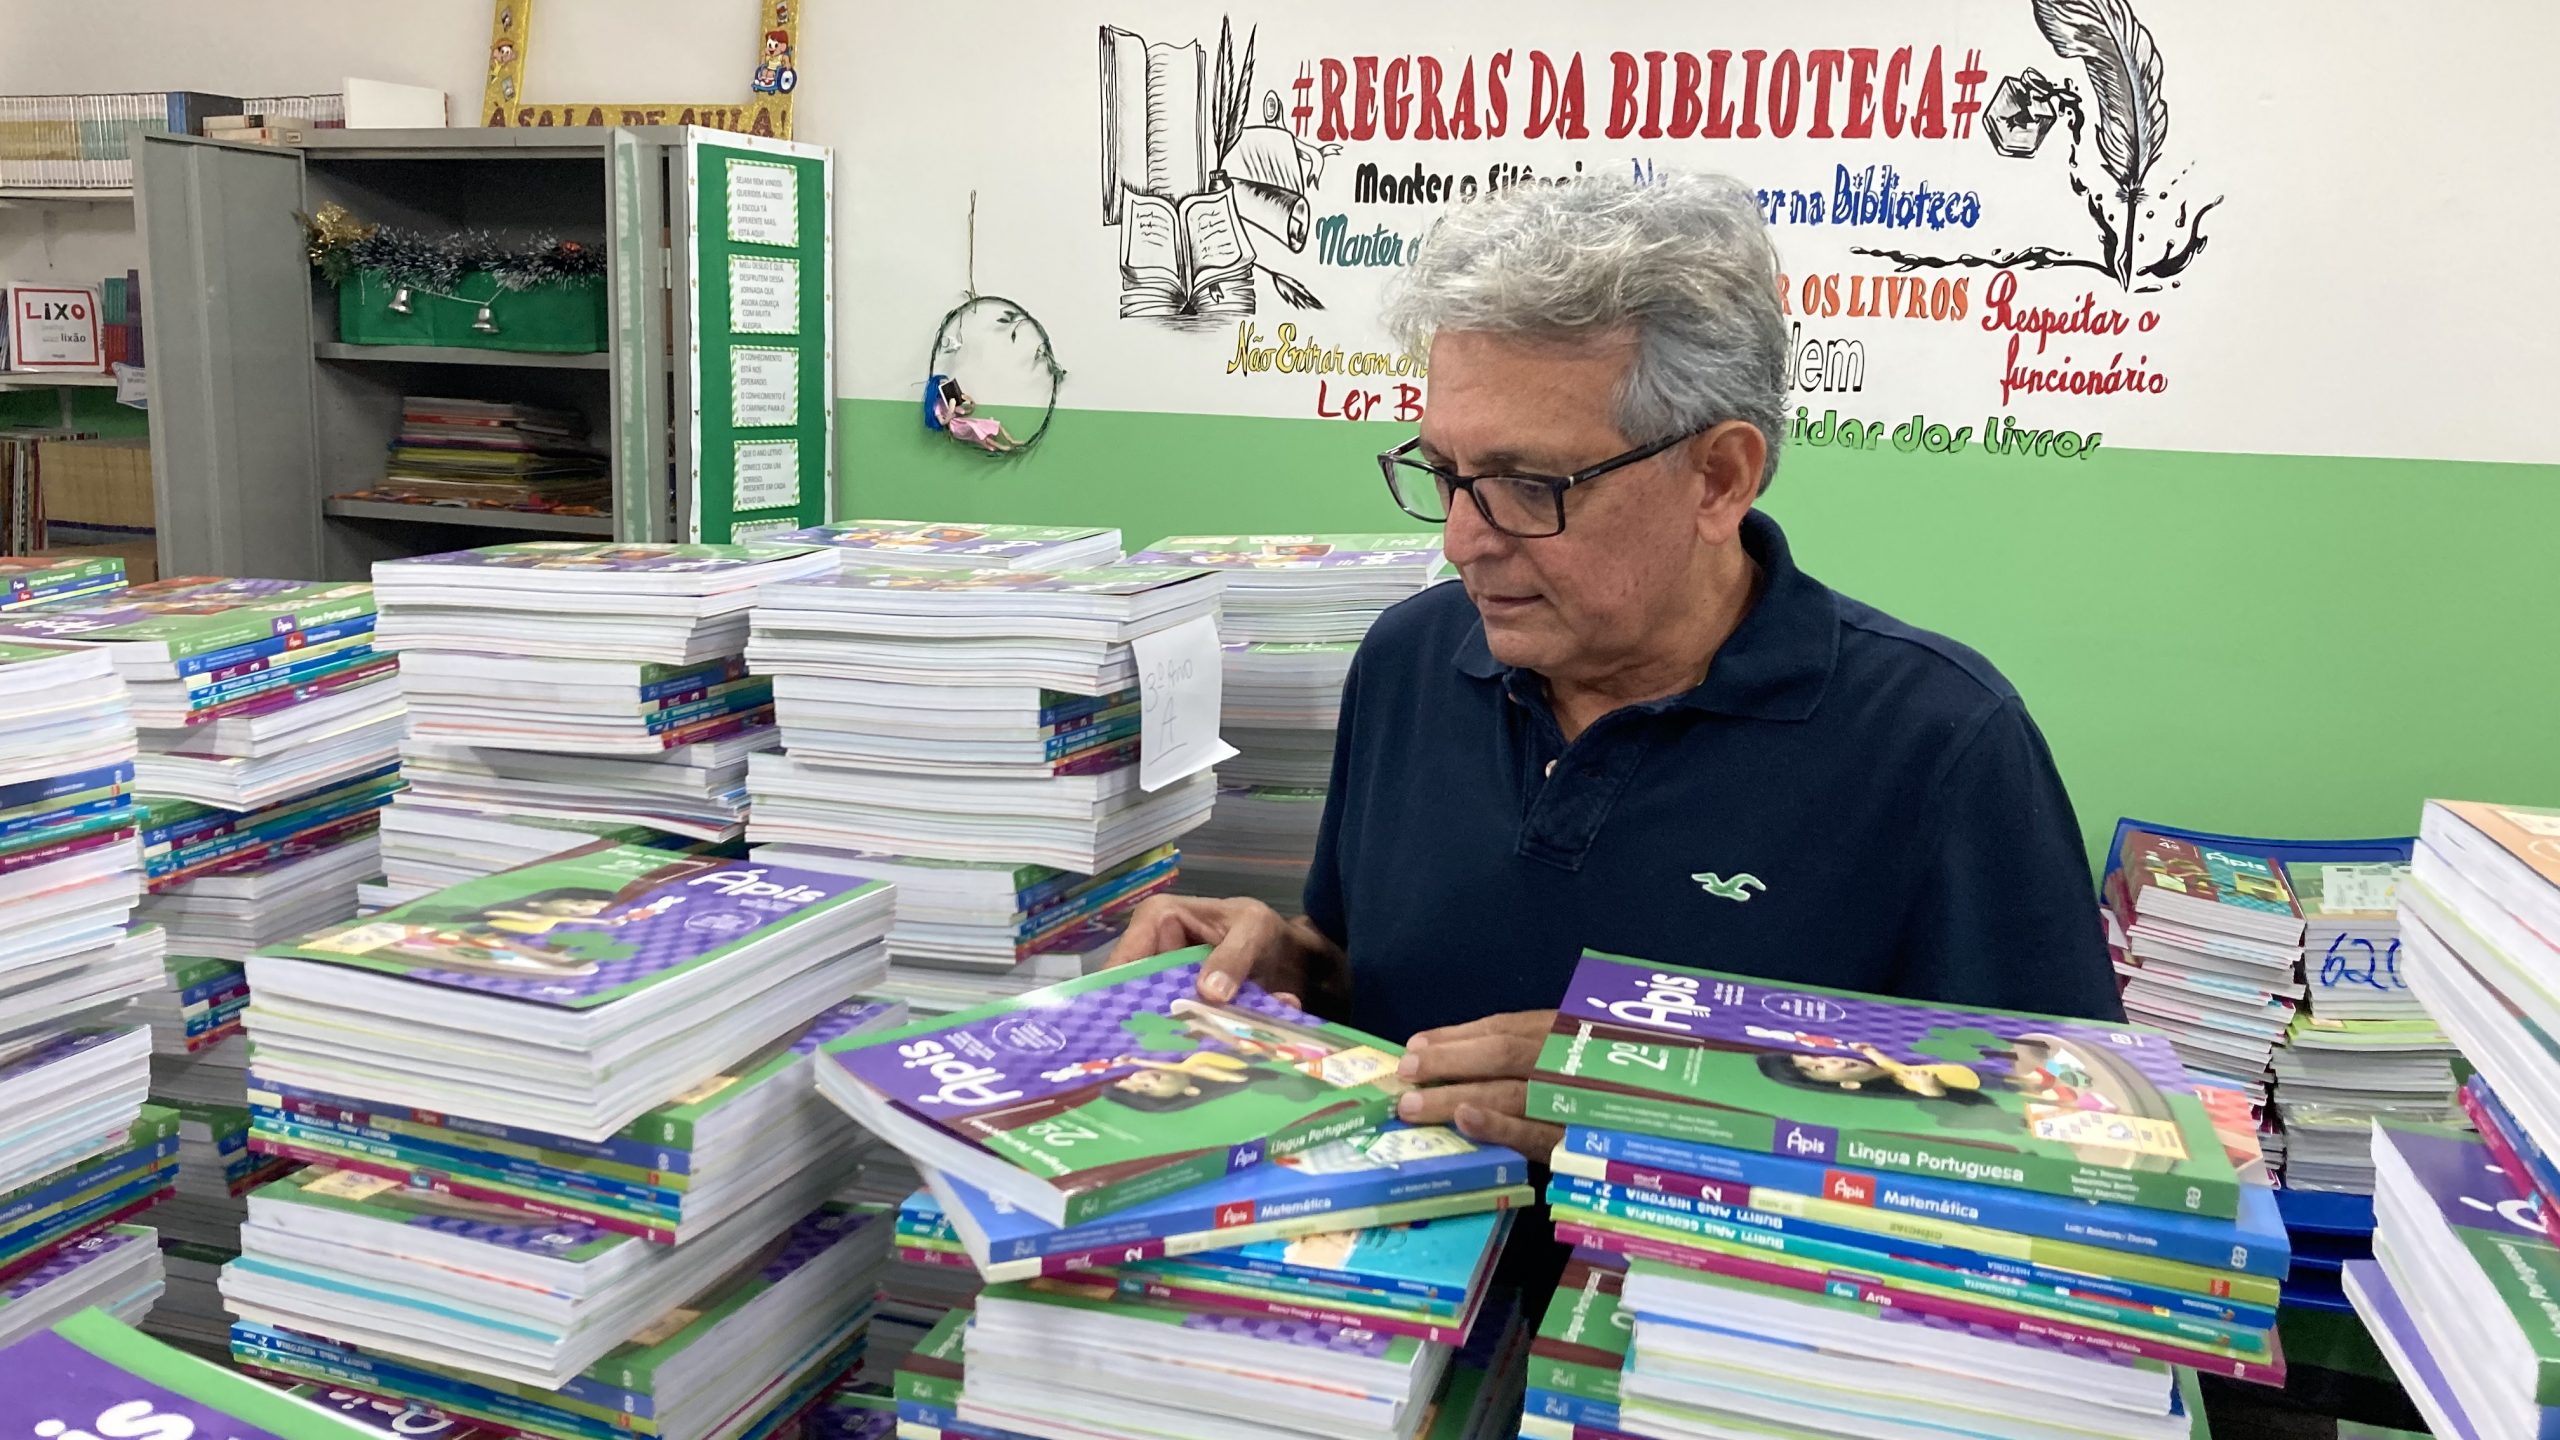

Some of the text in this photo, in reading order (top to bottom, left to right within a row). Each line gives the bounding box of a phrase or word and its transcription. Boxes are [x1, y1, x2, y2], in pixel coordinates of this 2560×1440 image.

[1290, 44, 1988, 143] #REGRAS DA BIBLIOTECA#
[1354, 162, 1453, 206] Manter
[742, 204, 760, 213] ESCOLA
[1789, 190, 1826, 226] na
[1315, 213, 1404, 268] Manter
[1802, 272, 1841, 318] OS
[1846, 273, 1970, 321] LIVROS
[1981, 269, 2160, 342] Respeitar o
[61, 332, 86, 343] lixão
[1226, 320, 1277, 378] Não
[1275, 322, 1345, 375] Entrar
[745, 353, 783, 362] CONHECIMENTO
[1999, 334, 2169, 407] funcionário
[745, 392, 782, 400] CONHECIMENTO
[1317, 379, 1381, 422] Ler
[1892, 415, 1973, 453] dos
[687, 868, 827, 903] Ápis
[1586, 972, 1712, 1031] Ápis
[898, 1040, 1024, 1106] Ápis
[1270, 1136, 1305, 1157] Língua
[1308, 1115, 1366, 1146] Portuguesa
[1786, 1127, 2025, 1183] Ápis Língua Portuguesa
[1261, 1197, 1332, 1218] Matemática
[1697, 1202, 1731, 1219] MAIS
[1834, 1178, 1865, 1200] Ápis
[1883, 1189, 1979, 1220] Matemática
[1625, 1206, 1700, 1232] GEOGRAFIA
[1704, 1222, 1737, 1240] MAIS
[1737, 1210, 1783, 1230] BURITI
[1740, 1230, 1785, 1250] BURITI
[1865, 1290, 1893, 1307] Arte
